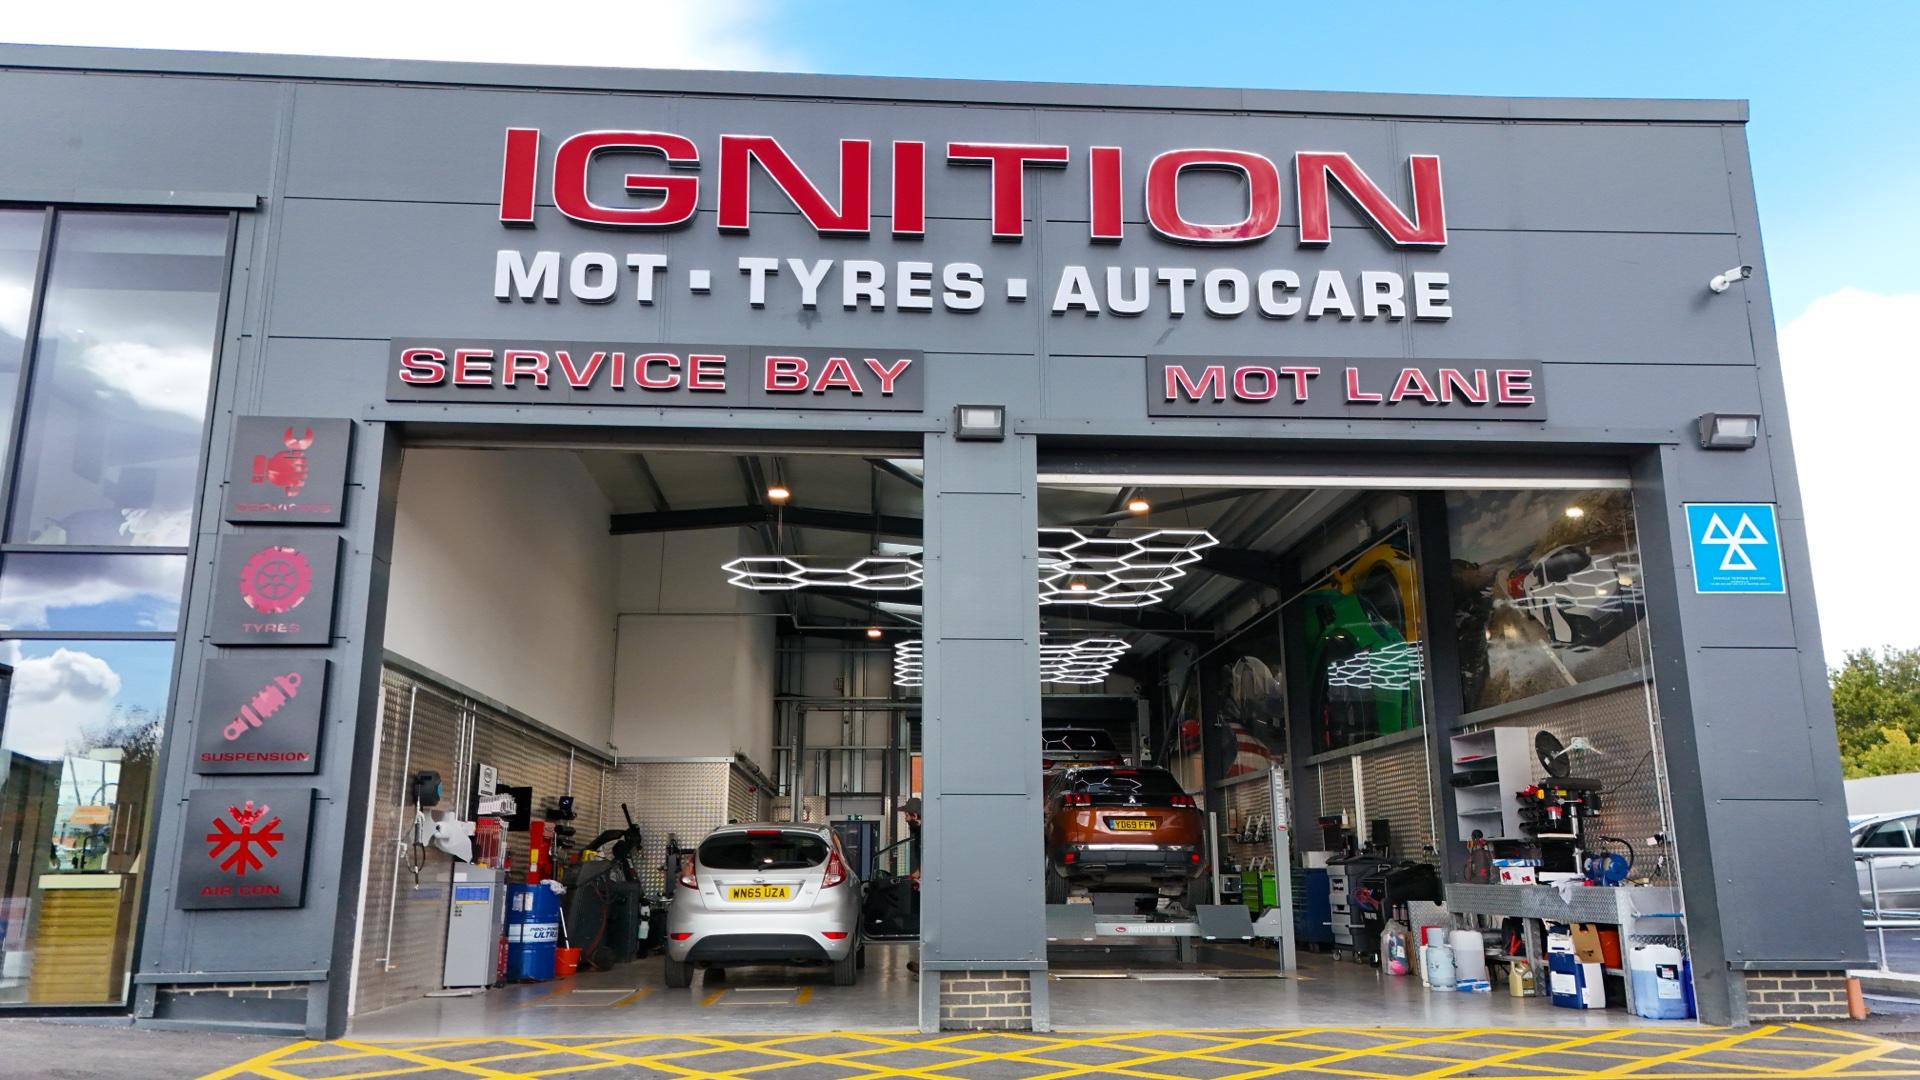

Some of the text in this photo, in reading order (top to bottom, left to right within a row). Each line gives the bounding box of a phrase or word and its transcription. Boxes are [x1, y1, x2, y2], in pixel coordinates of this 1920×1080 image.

[499, 127, 1448, 249] IGNITION
[494, 250, 1453, 321] MOT TYRES AUTOCARE
[398, 347, 912, 395] SERVICE BAY
[1164, 365, 1535, 405] MOT LANE
[241, 623, 300, 633] TYRES
[200, 751, 310, 762] SUSPENSION
[199, 884, 280, 897] AIR CON
[732, 887, 786, 899] WN65 UZA
